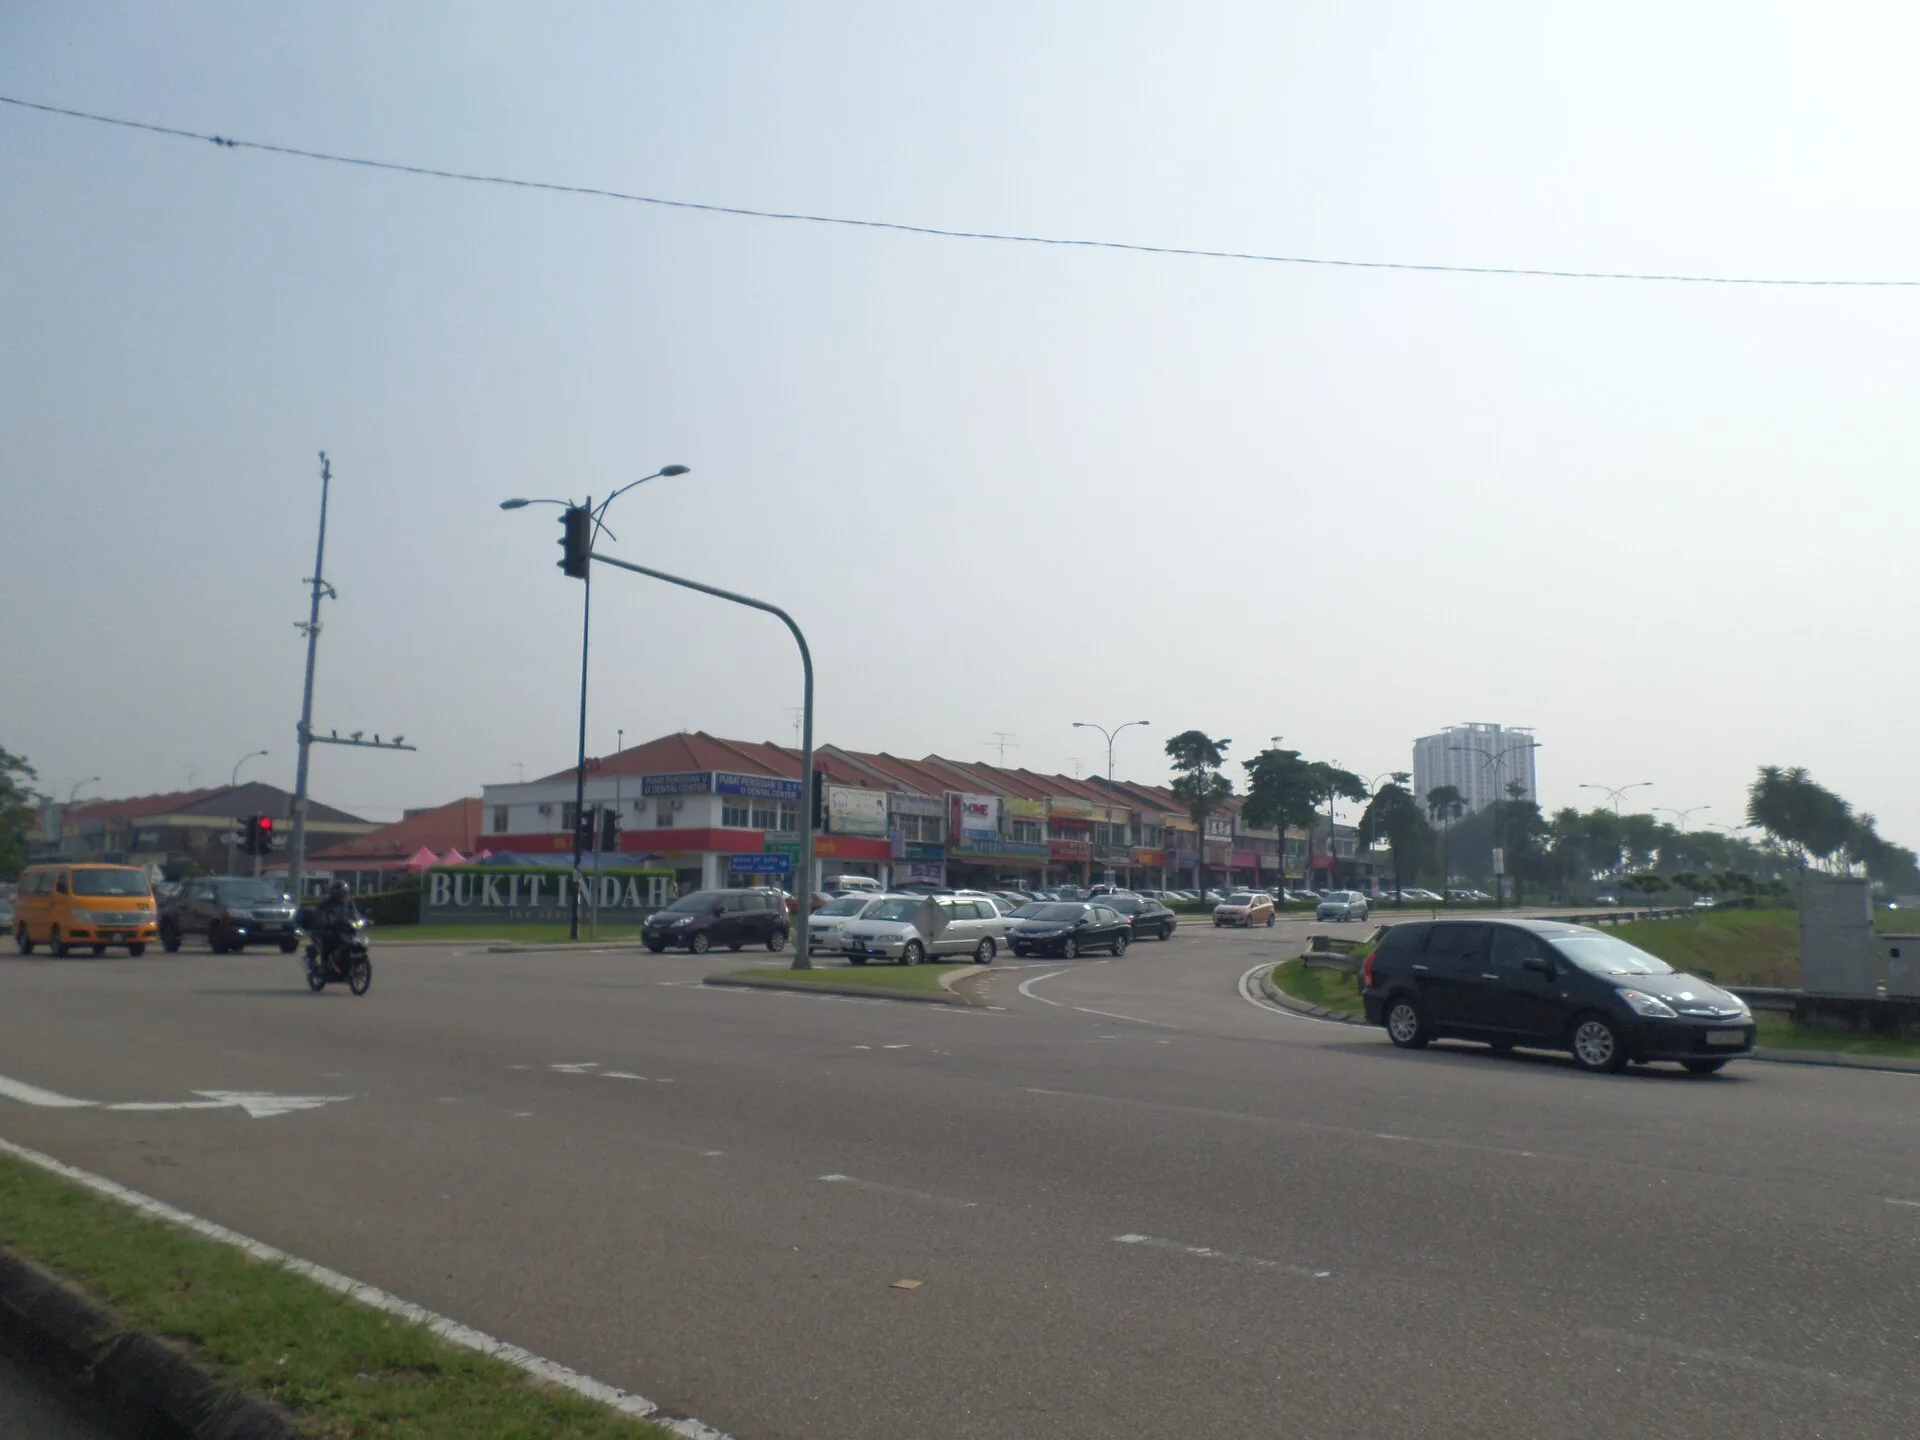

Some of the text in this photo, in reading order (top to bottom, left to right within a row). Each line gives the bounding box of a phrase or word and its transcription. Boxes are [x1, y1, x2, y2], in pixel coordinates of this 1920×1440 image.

[719, 774, 740, 785] PUSAT
[652, 785, 679, 794] DENTAL
[679, 783, 709, 793] CENTER
[747, 787, 772, 797] DENTAL
[771, 790, 796, 800] CENTER
[429, 872, 669, 907] BUKIT INDAH
